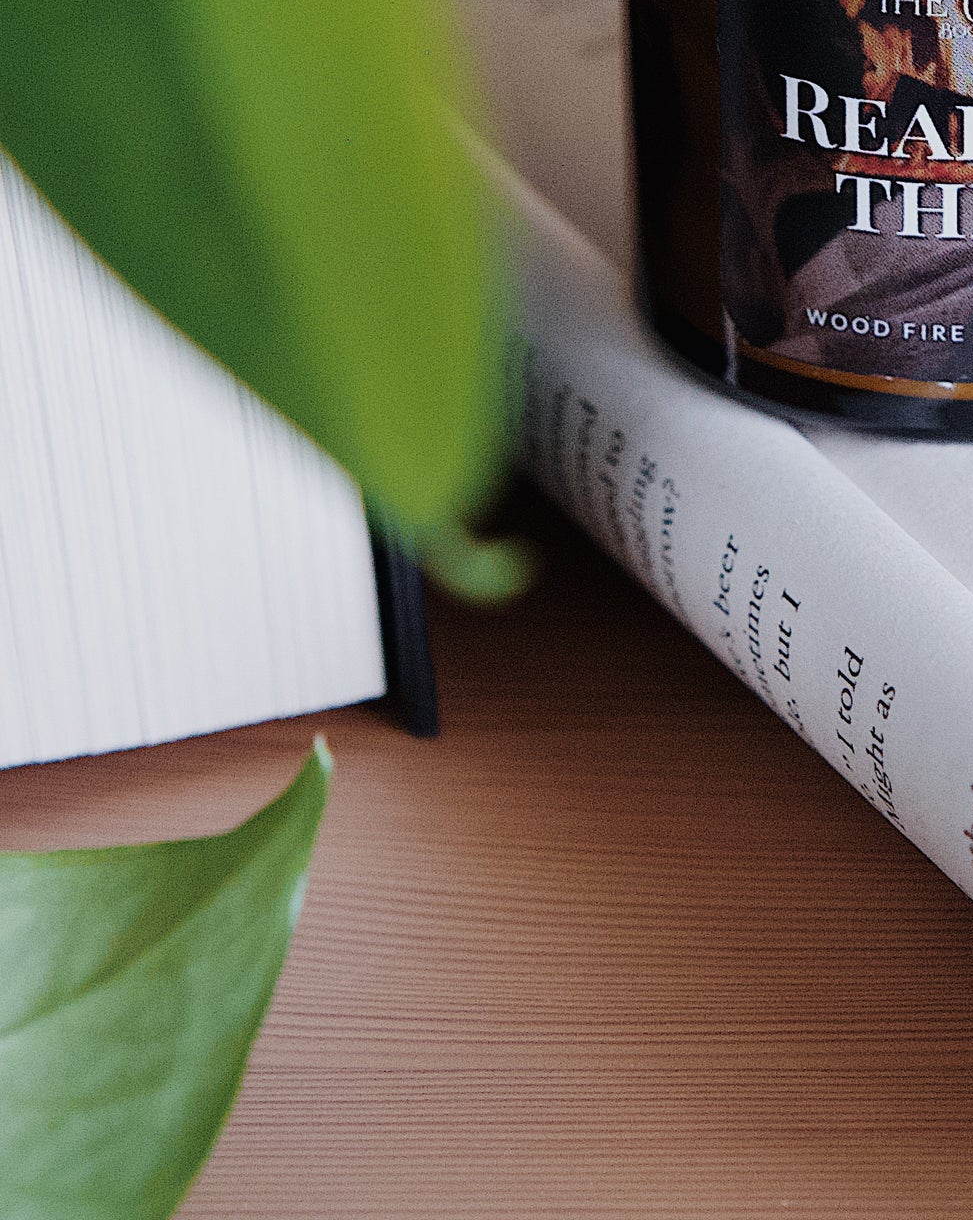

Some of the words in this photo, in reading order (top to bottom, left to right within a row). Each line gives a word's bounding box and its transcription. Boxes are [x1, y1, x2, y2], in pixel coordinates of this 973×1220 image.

[805, 307, 891, 339] WOOD
[902, 320, 966, 344] FIRE
[711, 532, 741, 616] beer
[773, 624, 793, 683] but
[837, 645, 865, 725] told
[876, 681, 897, 720] as
